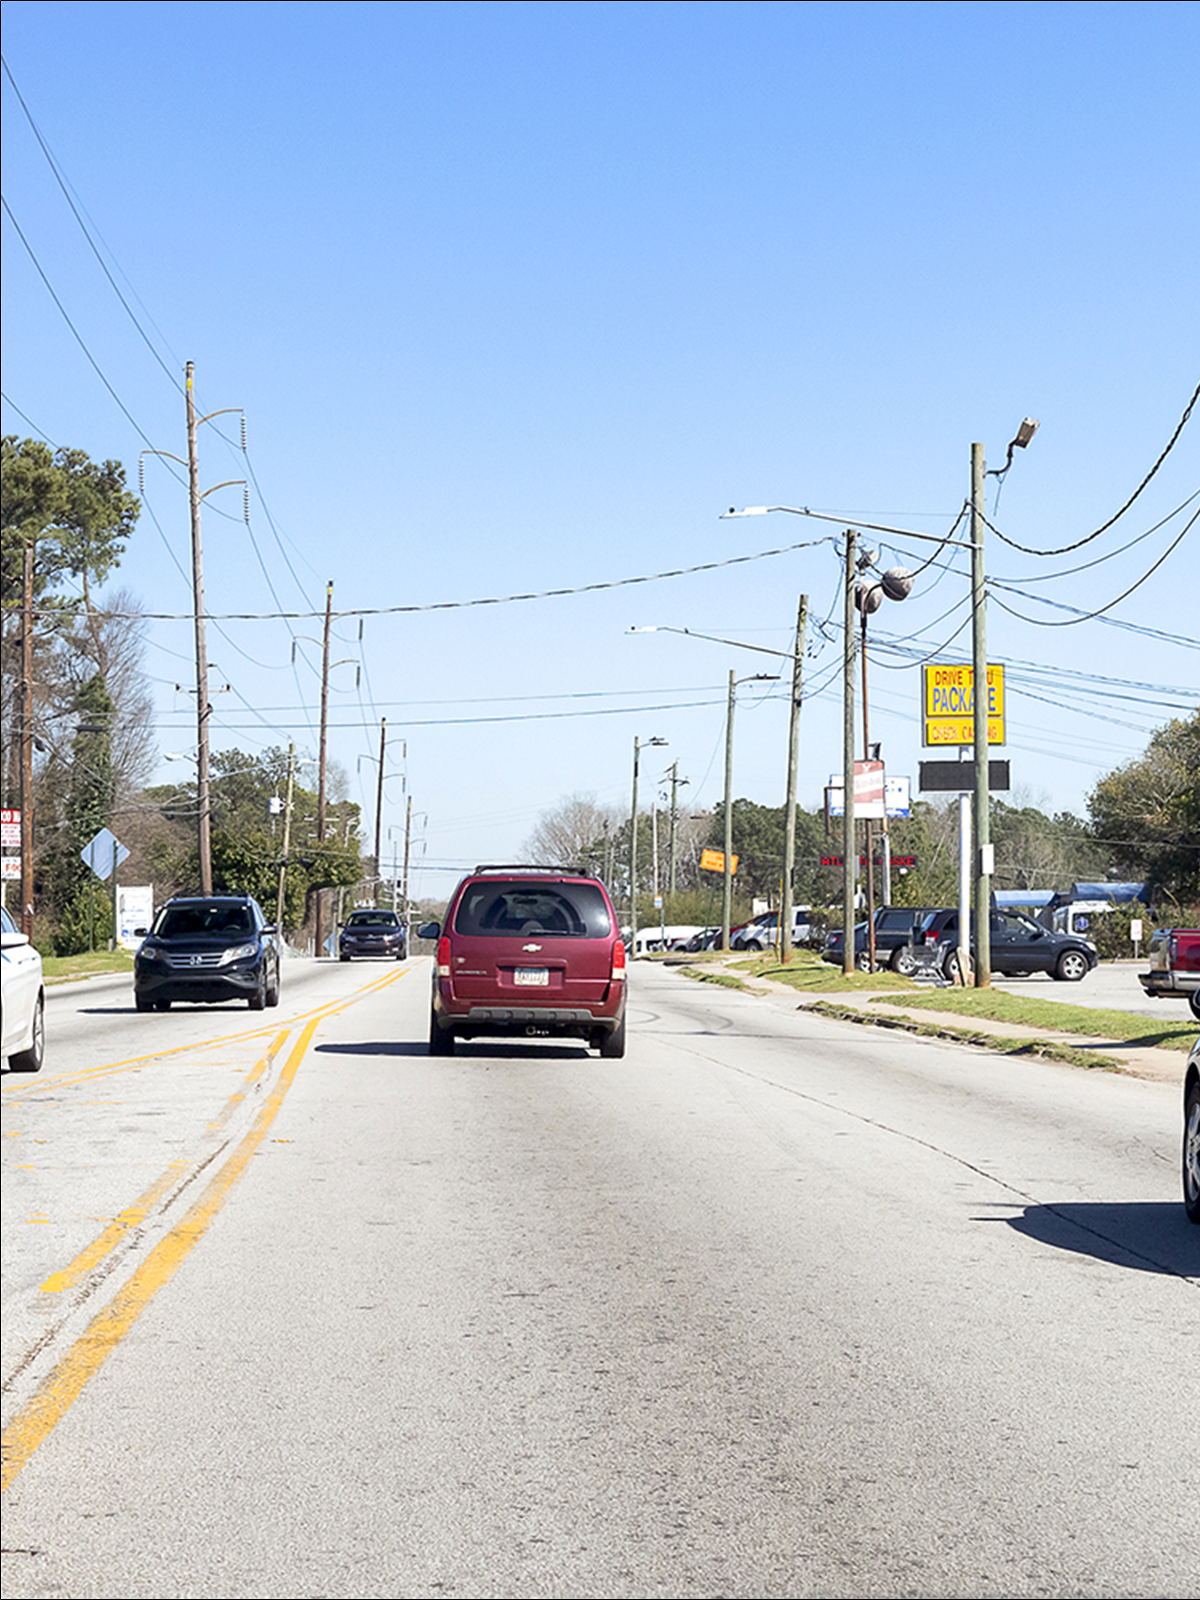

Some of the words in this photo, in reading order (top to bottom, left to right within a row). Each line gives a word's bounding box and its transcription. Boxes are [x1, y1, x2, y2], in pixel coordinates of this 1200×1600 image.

[934, 670, 963, 686] DRIVE
[968, 669, 995, 686] TU
[932, 686, 997, 712] PACKAE
[932, 725, 959, 741] CHECK
